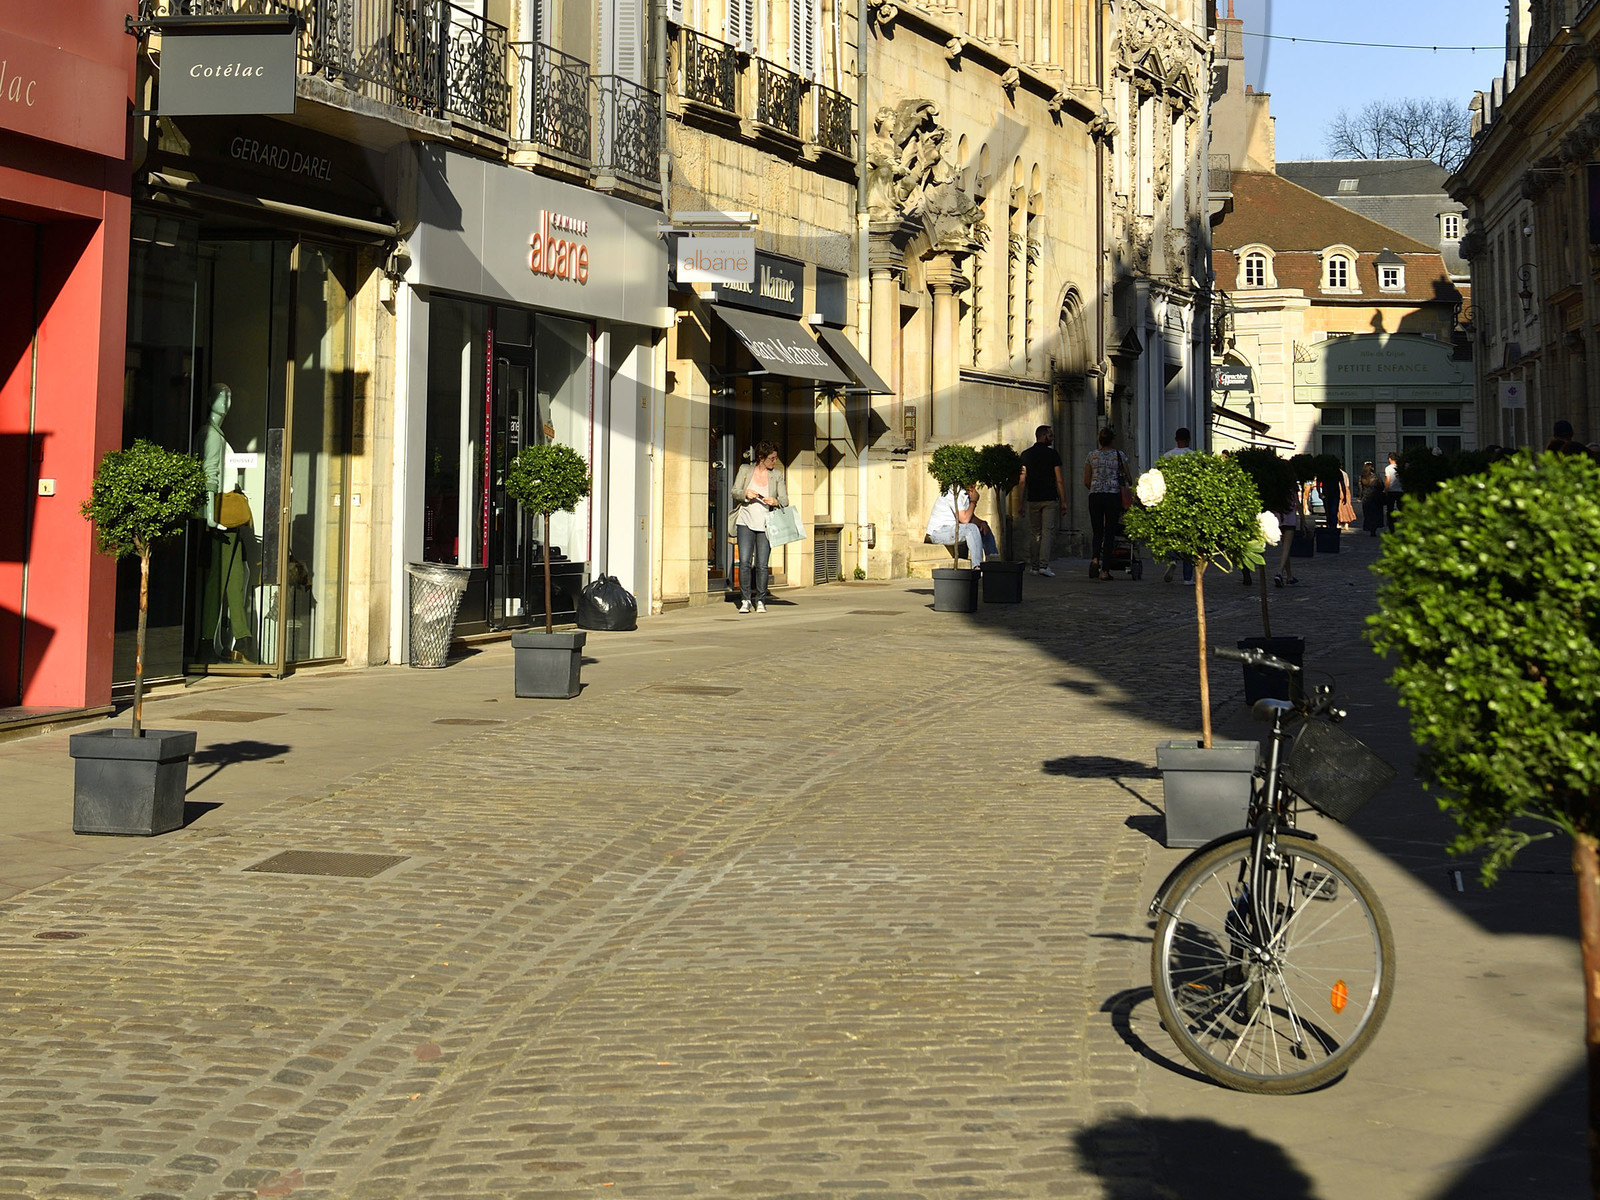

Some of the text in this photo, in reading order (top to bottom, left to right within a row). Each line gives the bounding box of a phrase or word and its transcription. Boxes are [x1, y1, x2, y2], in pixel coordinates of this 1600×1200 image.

[190, 63, 264, 78] Cotélac
[230, 137, 332, 181] GERARD DAREL
[529, 209, 589, 284] albane
[683, 249, 748, 271] albane
[760, 264, 795, 303] Marine
[1338, 364, 1428, 373] PETITE ENFANCE
